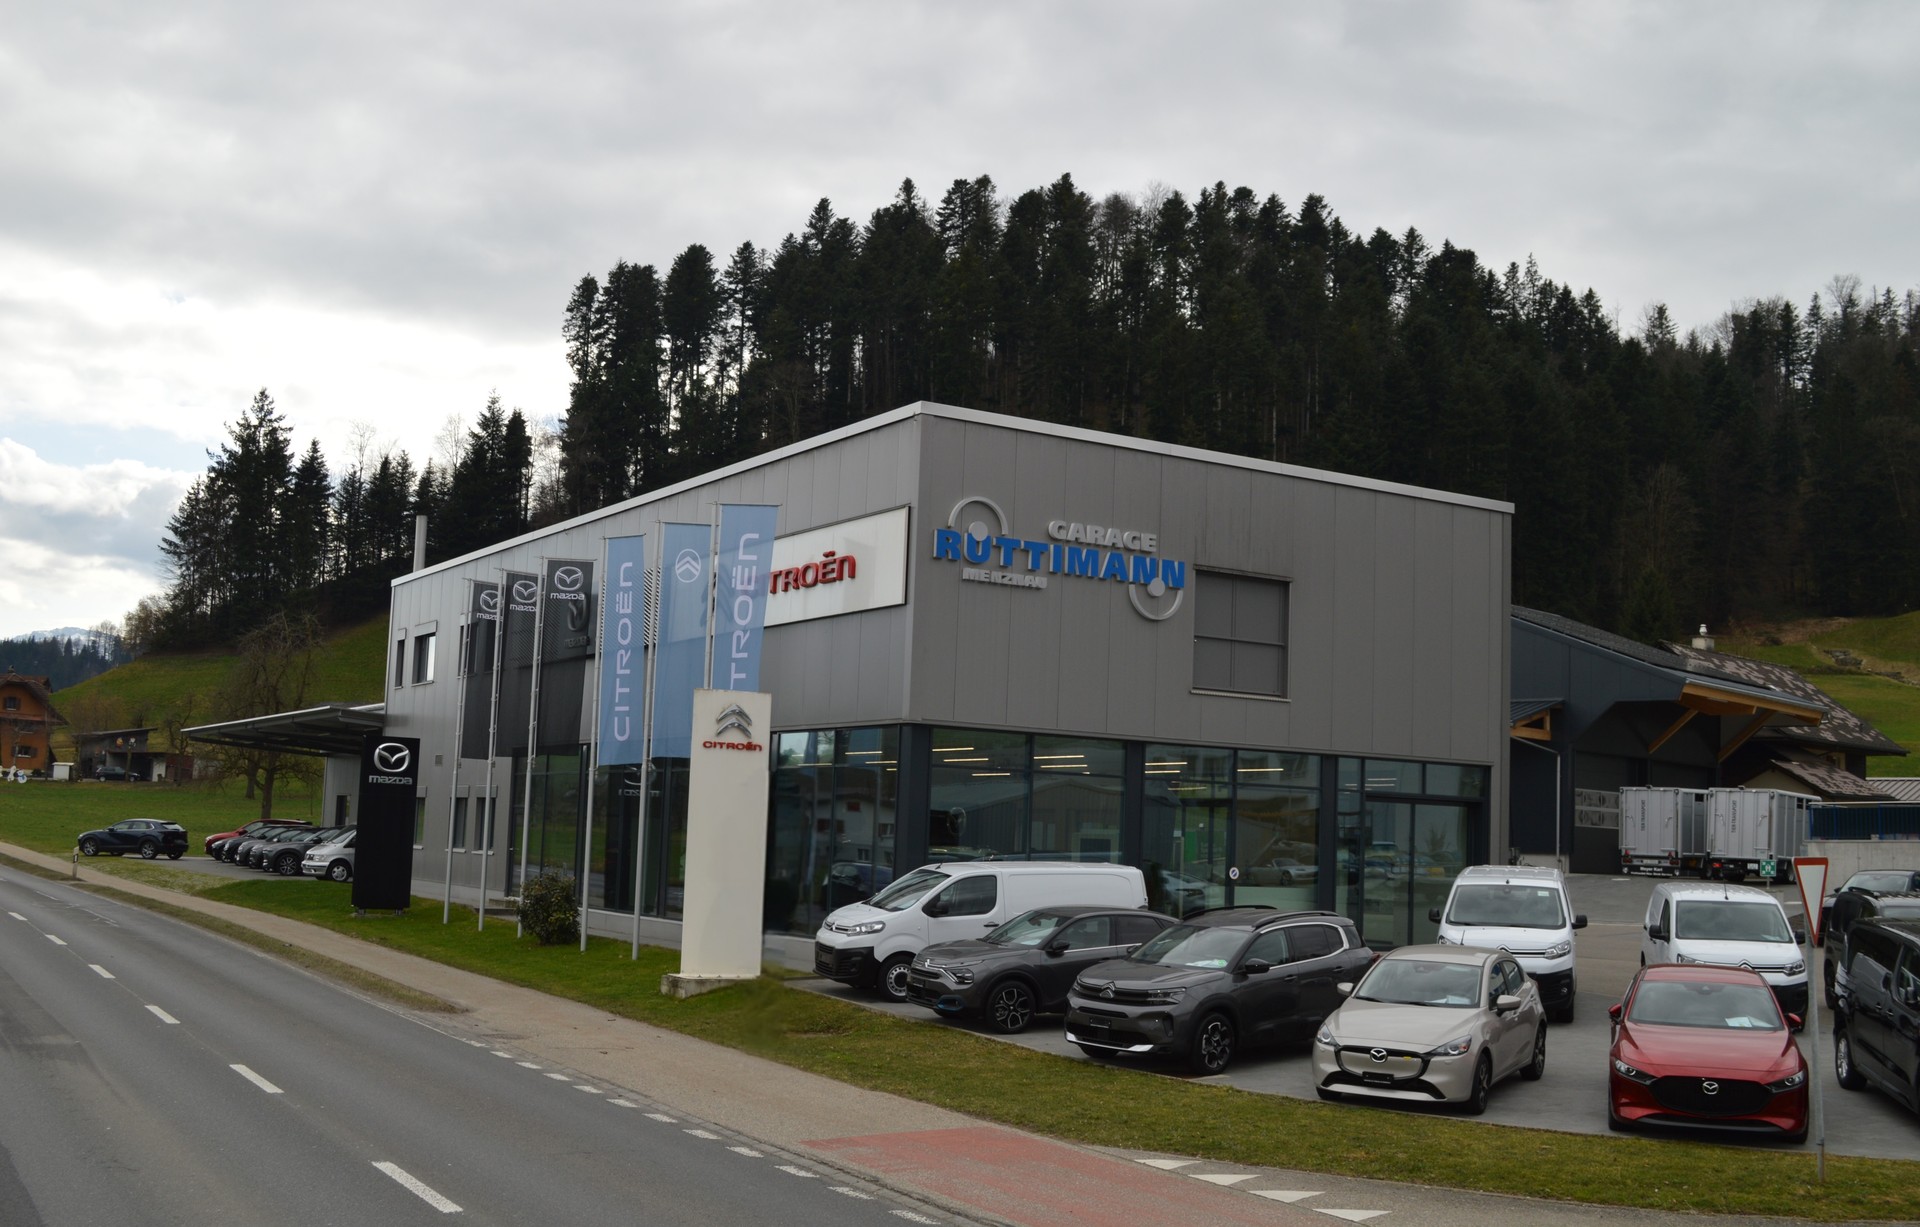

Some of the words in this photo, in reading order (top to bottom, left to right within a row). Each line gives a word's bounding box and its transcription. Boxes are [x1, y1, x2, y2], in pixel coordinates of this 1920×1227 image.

[1048, 520, 1157, 552] GARAGE
[769, 550, 857, 594] TROËN
[962, 568, 1047, 589] MENZNAU
[550, 592, 585, 600] mazda
[510, 603, 537, 612] mazd
[730, 533, 760, 690] TROËN
[614, 561, 633, 742] CITROËN
[703, 741, 762, 752] CITROËN
[368, 775, 413, 785] mazda
